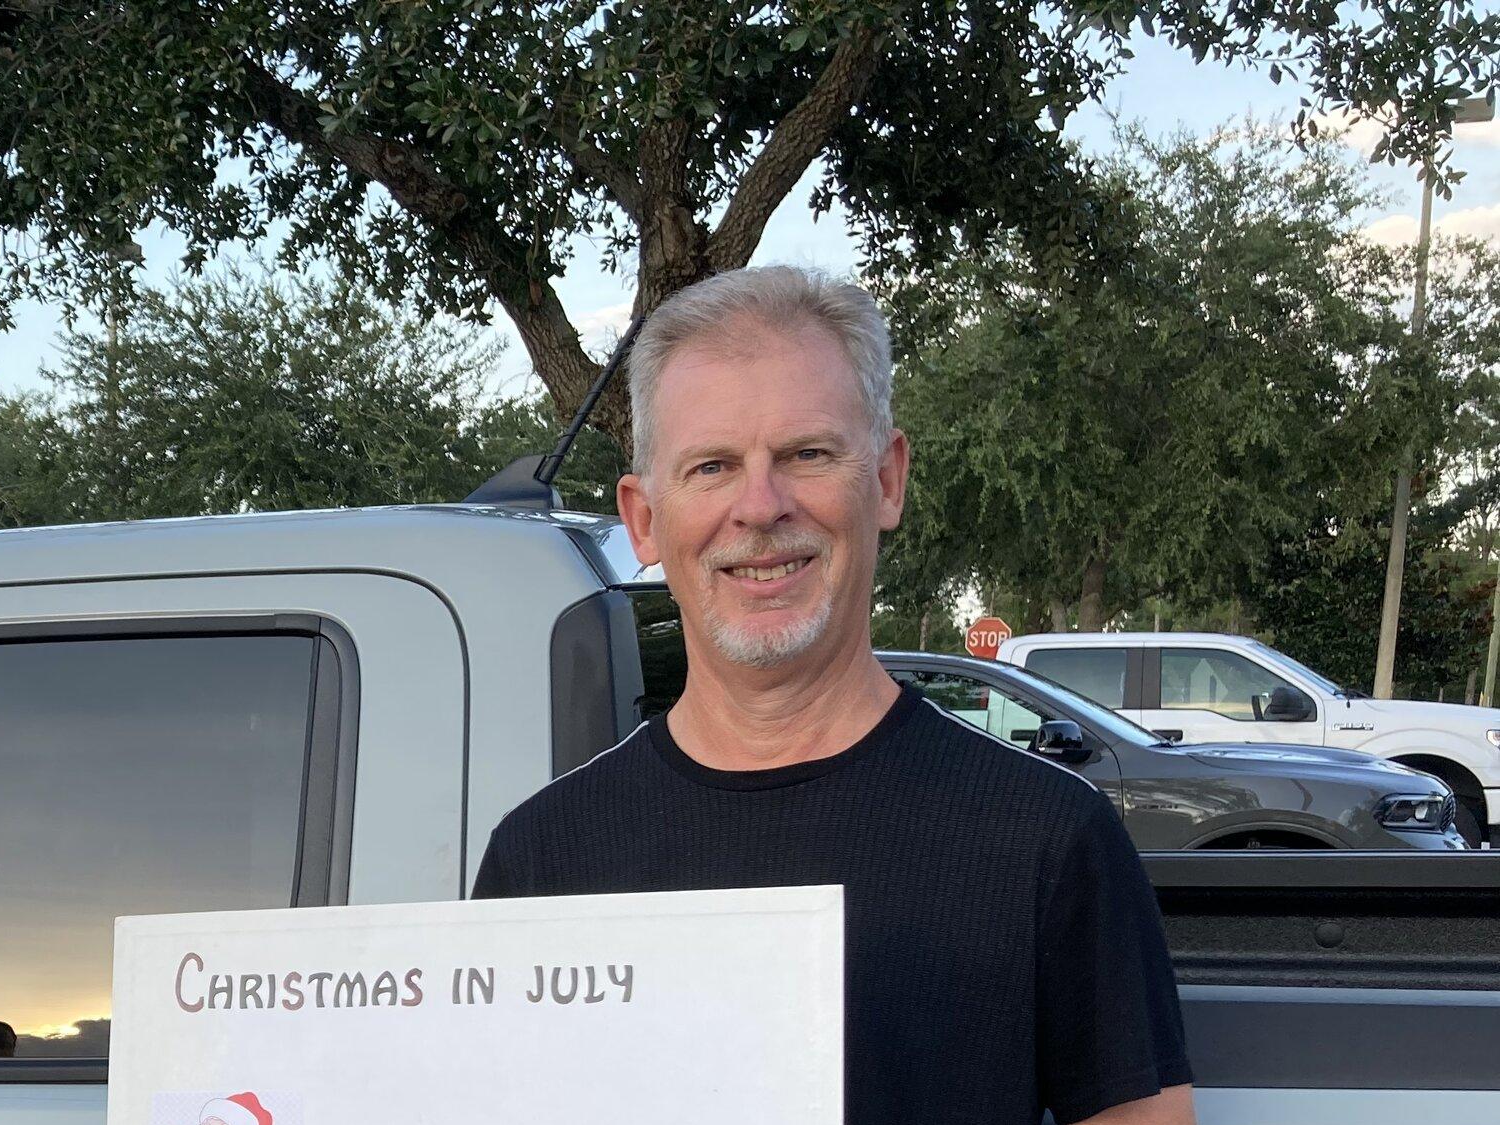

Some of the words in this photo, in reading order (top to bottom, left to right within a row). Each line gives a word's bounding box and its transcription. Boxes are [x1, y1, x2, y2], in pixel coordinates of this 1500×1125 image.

[969, 631, 1008, 648] STOP
[174, 951, 424, 1014] CHRISTMAS
[451, 965, 495, 1005] IN
[525, 964, 635, 1005] JULY
